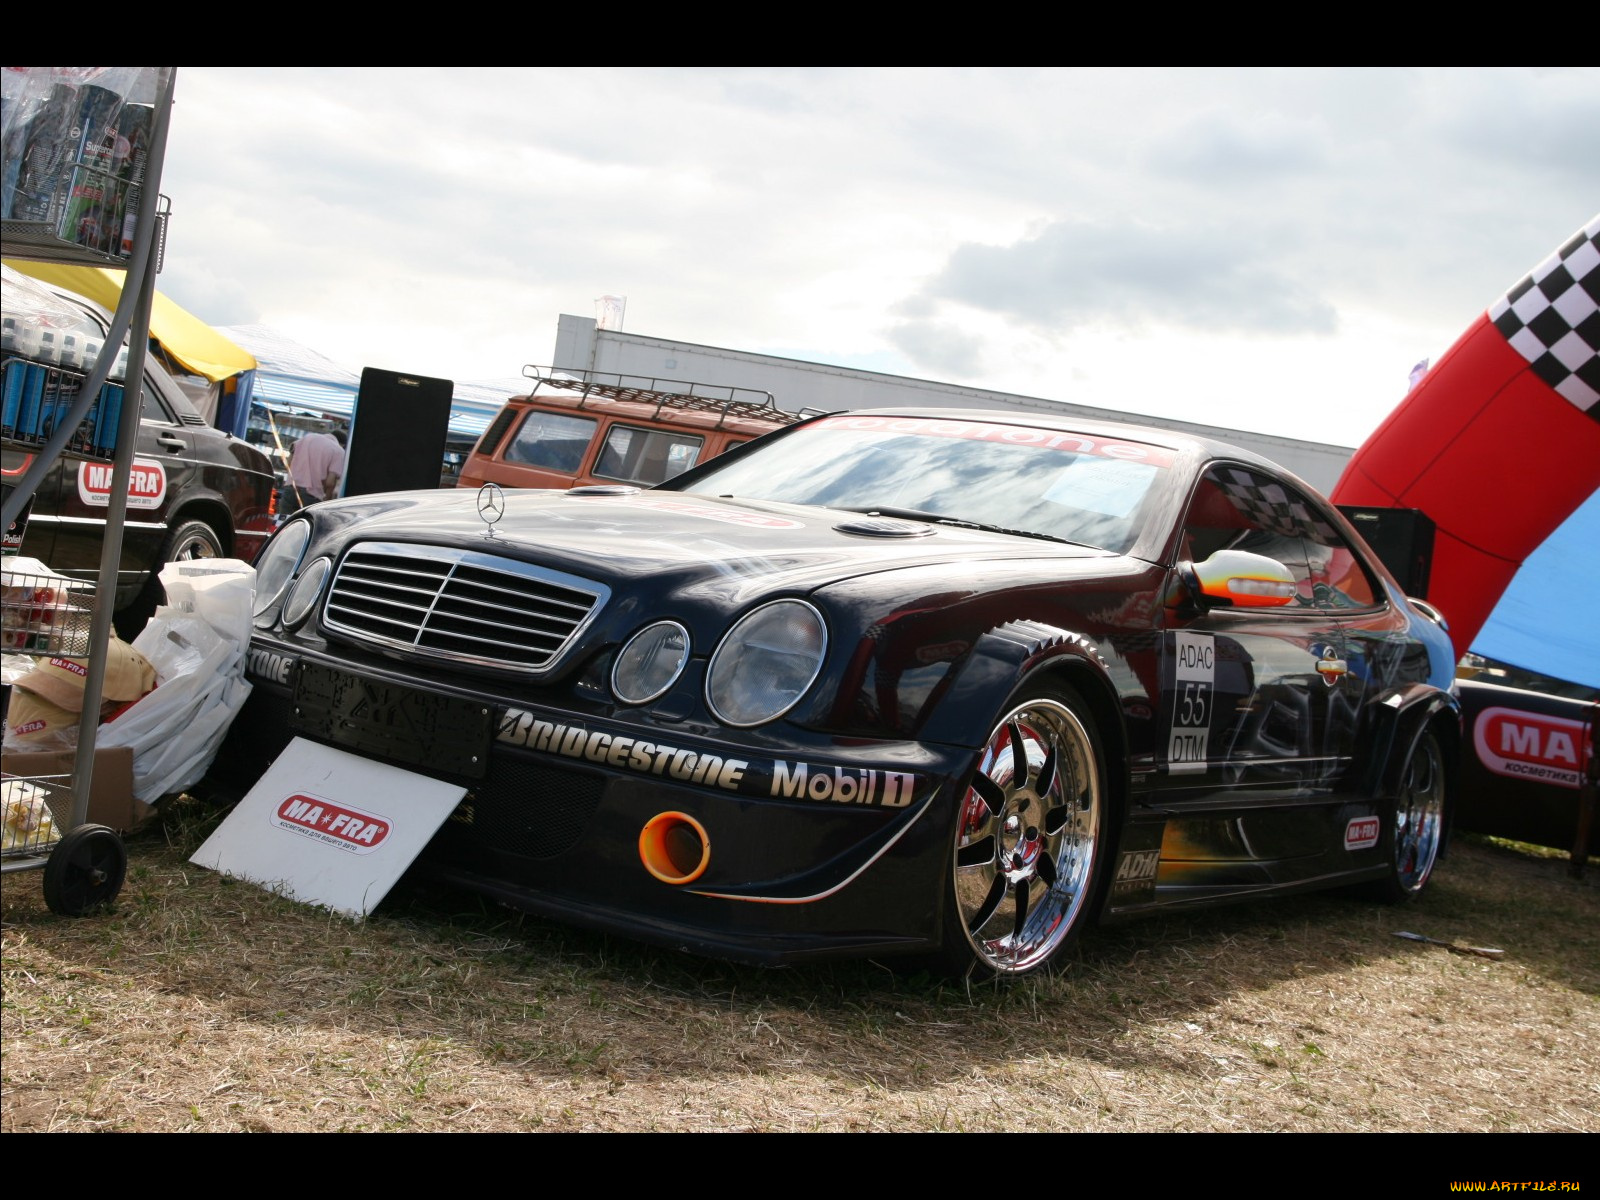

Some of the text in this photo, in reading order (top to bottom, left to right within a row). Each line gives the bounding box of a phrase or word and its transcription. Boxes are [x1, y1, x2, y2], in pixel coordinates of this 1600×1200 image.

[129, 471, 158, 493] FRA
[1179, 644, 1213, 669] ADAC
[1180, 682, 1207, 725] 55
[496, 707, 749, 790] BRIDGESTONE
[1172, 735, 1205, 762] DTM
[1501, 721, 1577, 764] MA
[770, 759, 915, 808] Mobil 1
[1504, 762, 1578, 783] косметика
